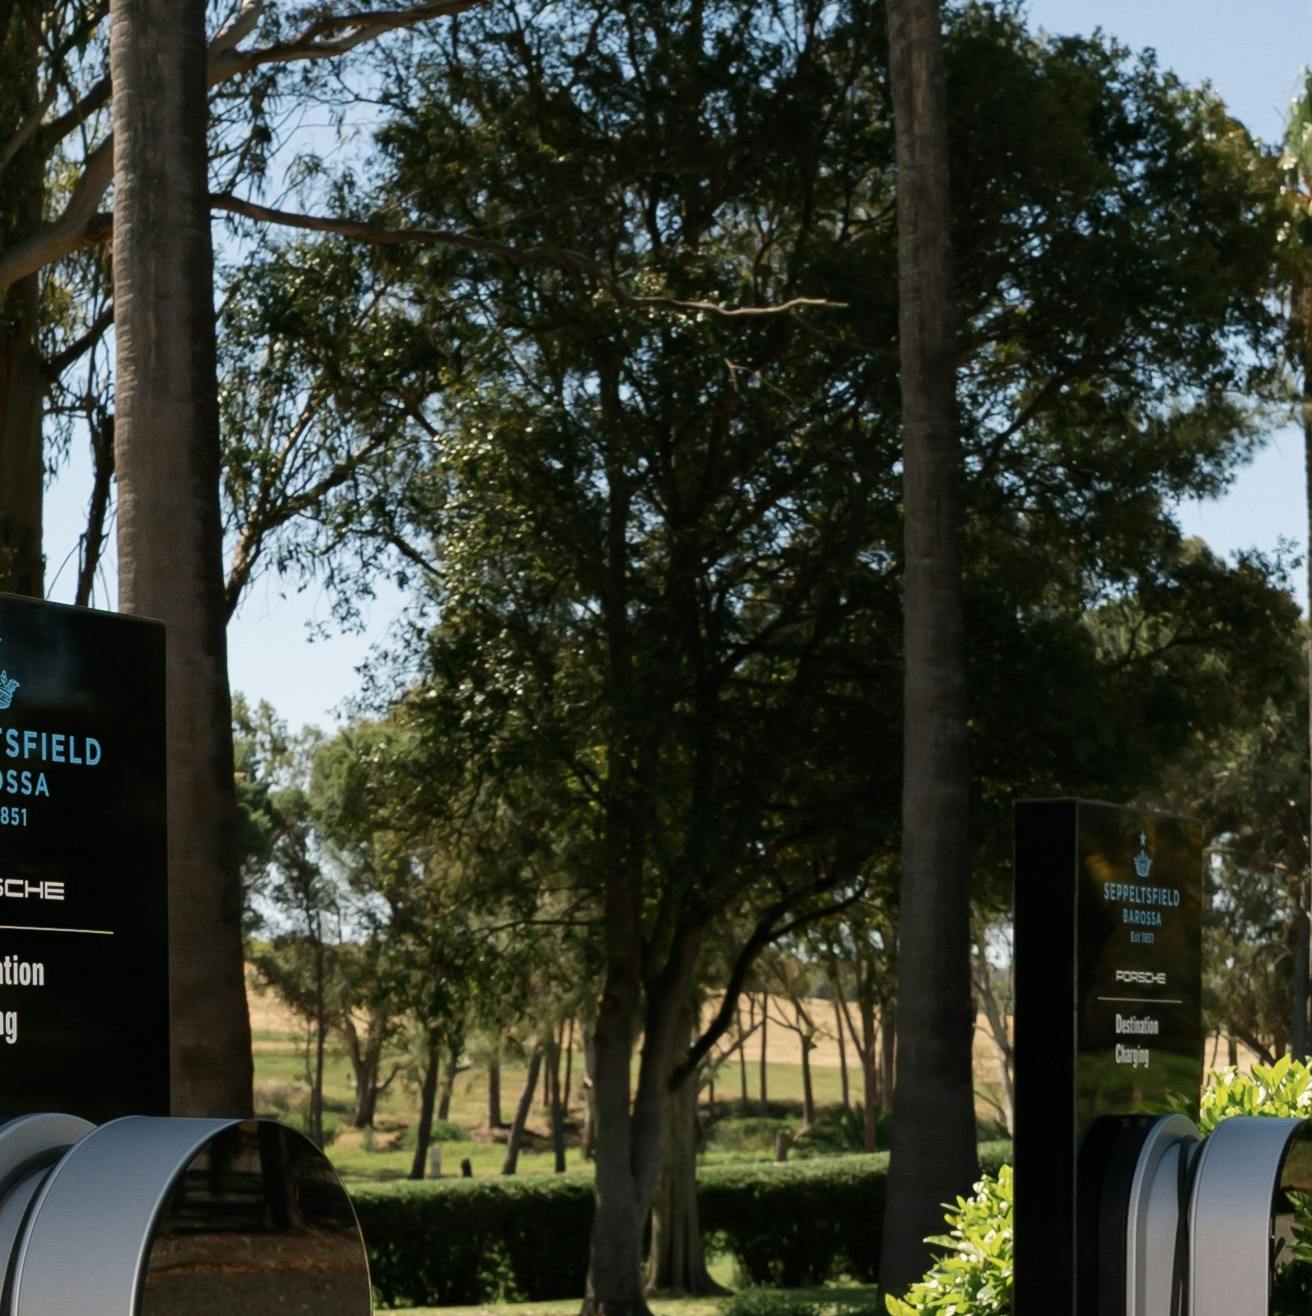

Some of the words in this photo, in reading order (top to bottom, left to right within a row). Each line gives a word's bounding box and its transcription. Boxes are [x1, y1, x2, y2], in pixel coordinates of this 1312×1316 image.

[1103, 882, 1180, 907] SEPPELTSFIELD
[1122, 908, 1162, 926] BAROSSA
[1115, 970, 1166, 984] PORSCHE
[1115, 1013, 1159, 1035] Destination
[1115, 1043, 1150, 1069] Charging
